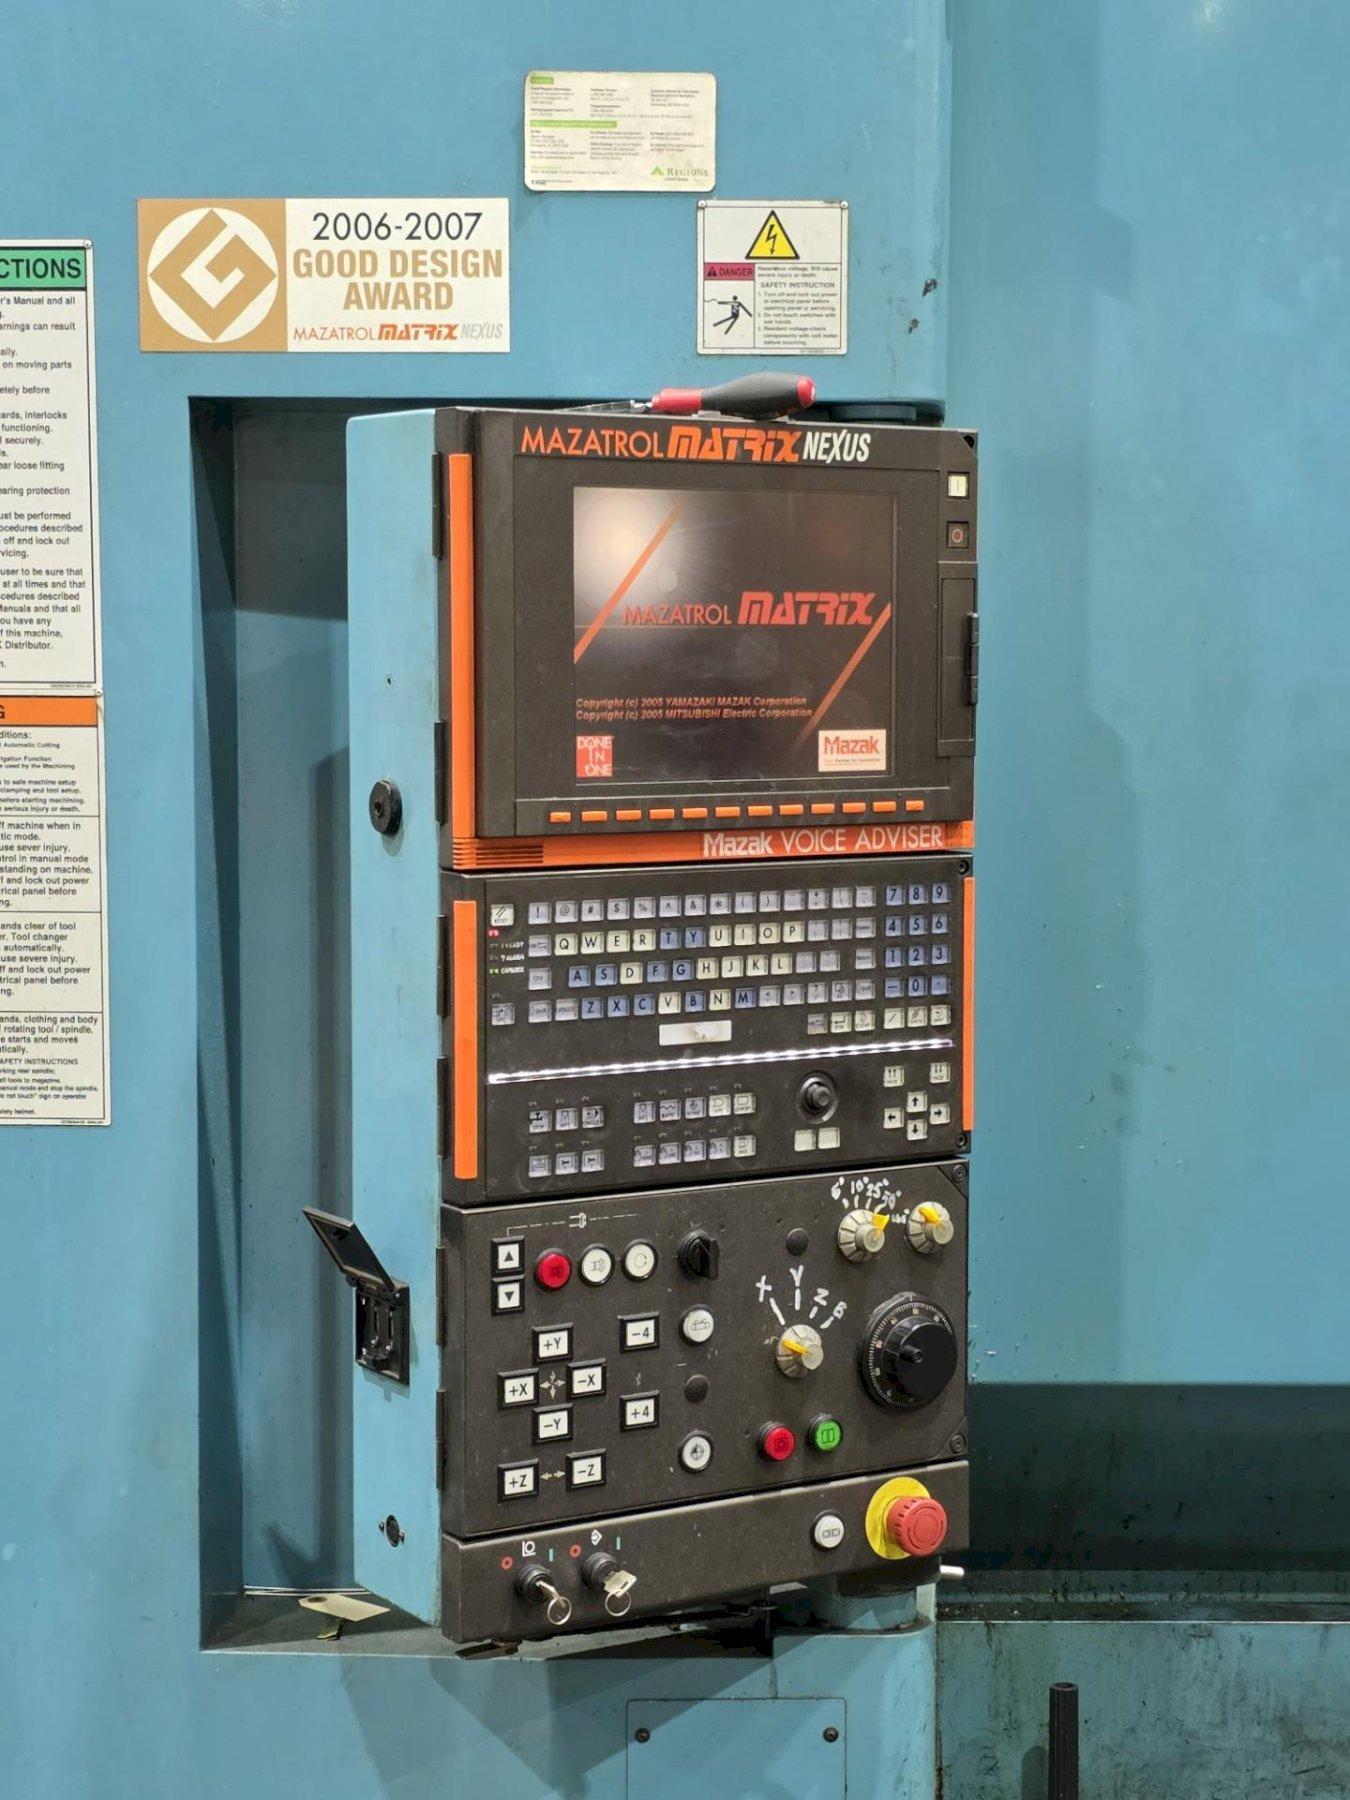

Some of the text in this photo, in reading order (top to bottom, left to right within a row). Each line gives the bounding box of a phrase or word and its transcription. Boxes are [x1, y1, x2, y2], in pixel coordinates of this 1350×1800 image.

[313, 212, 483, 241] 2006-2007
[293, 249, 502, 278] GOOD DESIGN
[719, 268, 753, 276] DANGER
[14, 297, 75, 305] Manual and all
[343, 282, 453, 311] AWARD
[51, 322, 75, 330] result
[294, 326, 375, 341] MAZATROL
[461, 323, 503, 339] NEXUS
[16, 361, 47, 370] moving
[51, 361, 71, 370] parts
[25, 411, 67, 419] interlocks
[521, 425, 663, 459] MAZATROL
[803, 429, 871, 463] NEXUS
[40, 462, 64, 471] fitting
[27, 487, 70, 496] protection
[28, 512, 71, 521] performed
[622, 605, 732, 625] MAZATROL
[576, 696, 807, 710] Copyright (c) 2005 YAMAZAKI MAZAK Corporation
[576, 711, 624, 722] Copyright
[626, 711, 638, 721] (c)
[665, 710, 721, 718] MITSUBISHI
[723, 709, 756, 718] Electric
[759, 709, 812, 719] Corporation
[577, 737, 612, 749] DONE
[824, 736, 879, 755] Mazak
[585, 764, 612, 776] ONE
[703, 825, 943, 858] Mazak VOICE ADVISER
[23, 888, 45, 896] panel
[890, 886, 942, 901] 7 8 9
[888, 917, 942, 932] 4 5 6
[33, 933, 67, 942] changer
[560, 938, 569, 950] Q
[585, 937, 598, 948] W
[615, 936, 620, 946] E
[640, 935, 646, 945] R
[666, 932, 671, 943] T
[690, 932, 696, 942] Y
[715, 930, 722, 941] U
[764, 927, 772, 938] O
[790, 926, 795, 936] P
[891, 948, 942, 962] 1 2 3
[573, 958, 782, 981] A S D F G H J K L
[913, 980, 919, 991] 0
[588, 992, 749, 1013] Z X C V B N M
[24, 1015, 57, 1024] clothing
[78, 1016, 98, 1024] body
[4, 1026, 35, 1035] rotating
[789, 1265, 804, 1287] Y
[632, 1327, 650, 1338] -4
[543, 1337, 562, 1350] +Y
[578, 1374, 595, 1386] -X
[509, 1382, 528, 1396] +X
[631, 1405, 650, 1419] +4
[544, 1418, 561, 1430] -Y
[577, 1464, 595, 1477] -Z
[509, 1474, 527, 1488] +Z
